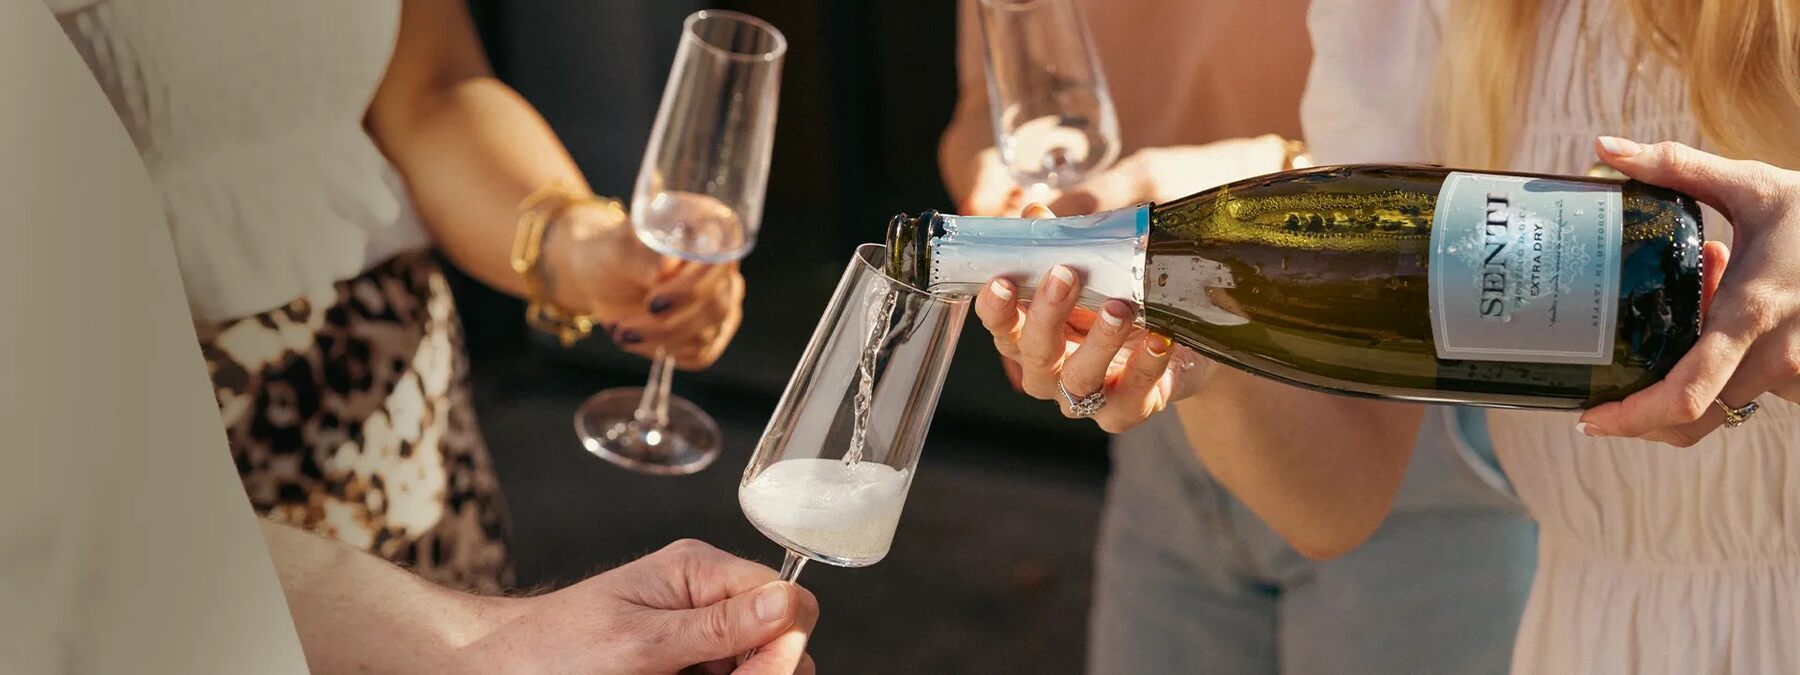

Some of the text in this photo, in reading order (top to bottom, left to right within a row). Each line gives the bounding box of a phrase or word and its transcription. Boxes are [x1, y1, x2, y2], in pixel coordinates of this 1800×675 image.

[1479, 193, 1509, 318] SENTI
[1530, 223, 1543, 297] EXTRA DRY
